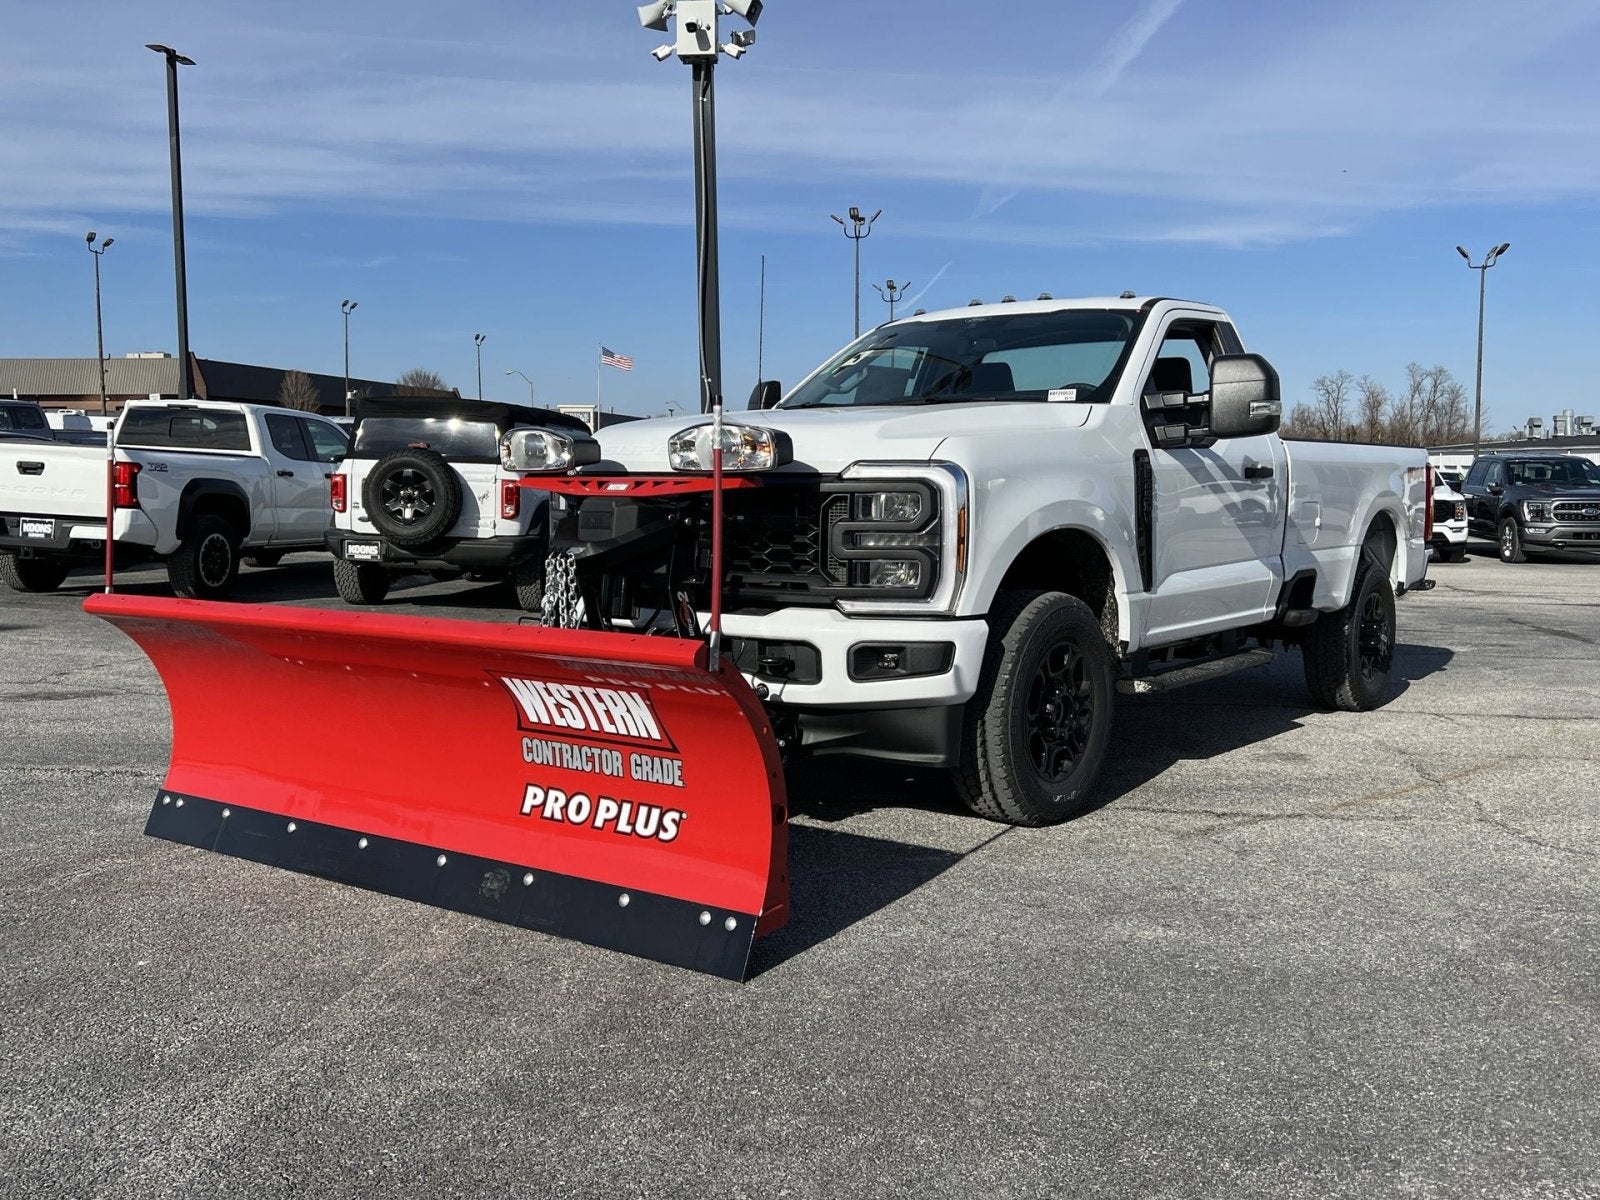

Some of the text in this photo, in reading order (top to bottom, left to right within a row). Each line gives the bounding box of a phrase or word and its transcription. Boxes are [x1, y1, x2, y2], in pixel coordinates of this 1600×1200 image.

[22, 522, 52, 534] KOONS
[348, 544, 379, 555] KOONS
[500, 676, 662, 740] WESTERN
[521, 736, 685, 787] CONTRACTOR GRADE
[520, 783, 682, 842] PRO PLUS
